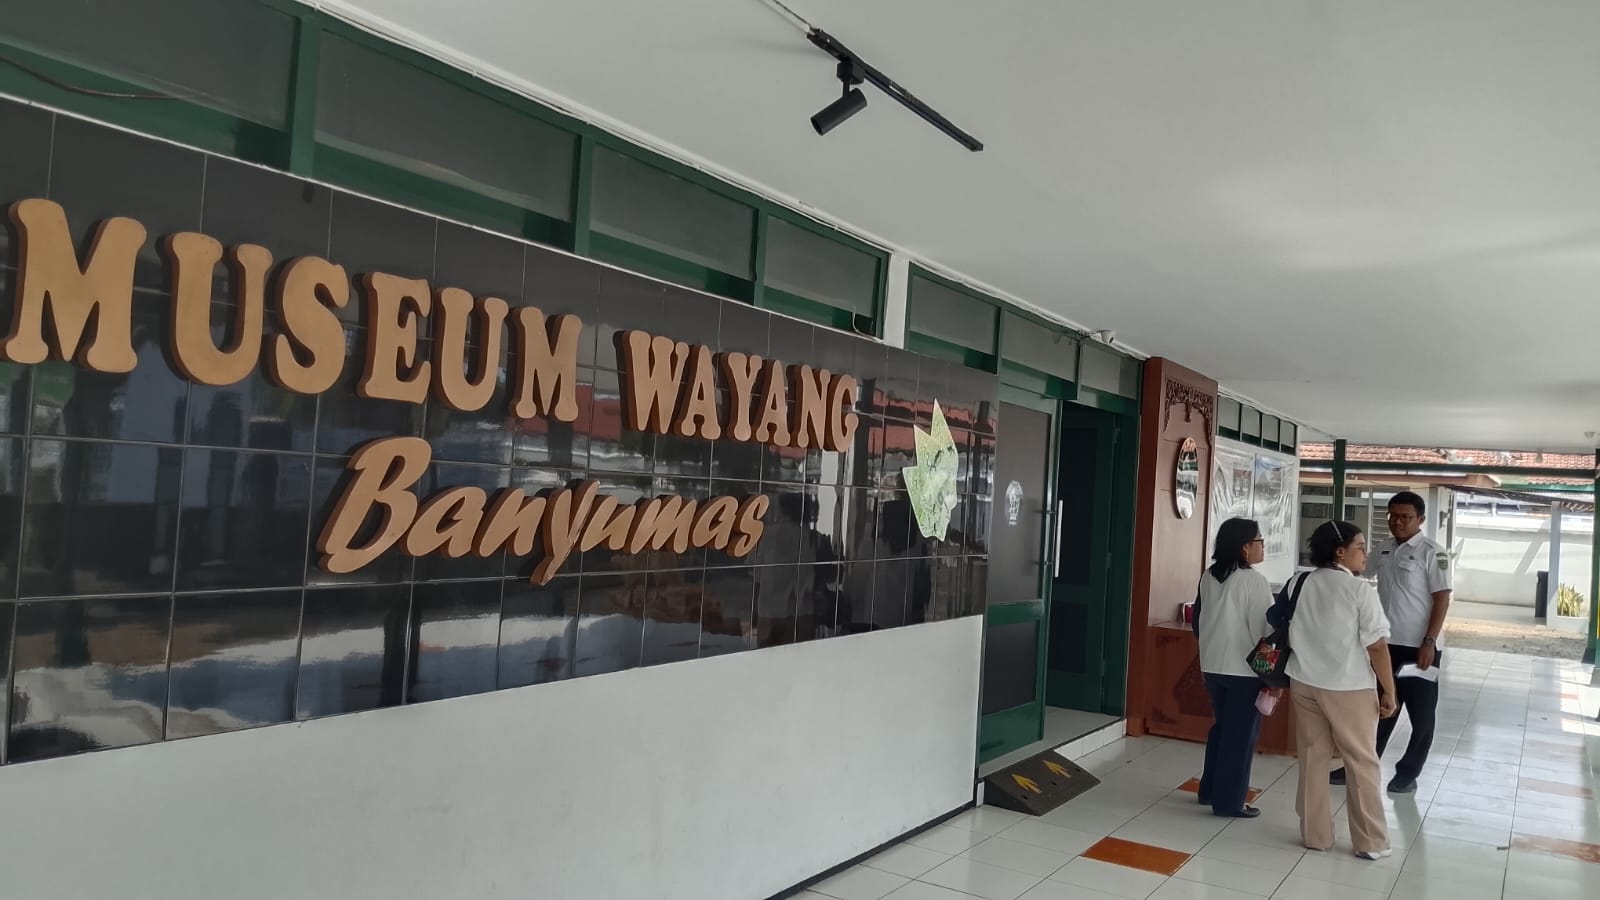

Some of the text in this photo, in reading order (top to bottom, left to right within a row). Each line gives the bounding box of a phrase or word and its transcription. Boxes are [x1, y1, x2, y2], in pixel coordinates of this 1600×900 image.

[4, 198, 858, 452] MUSEUM WAYANG
[318, 437, 769, 586] Banyumas
